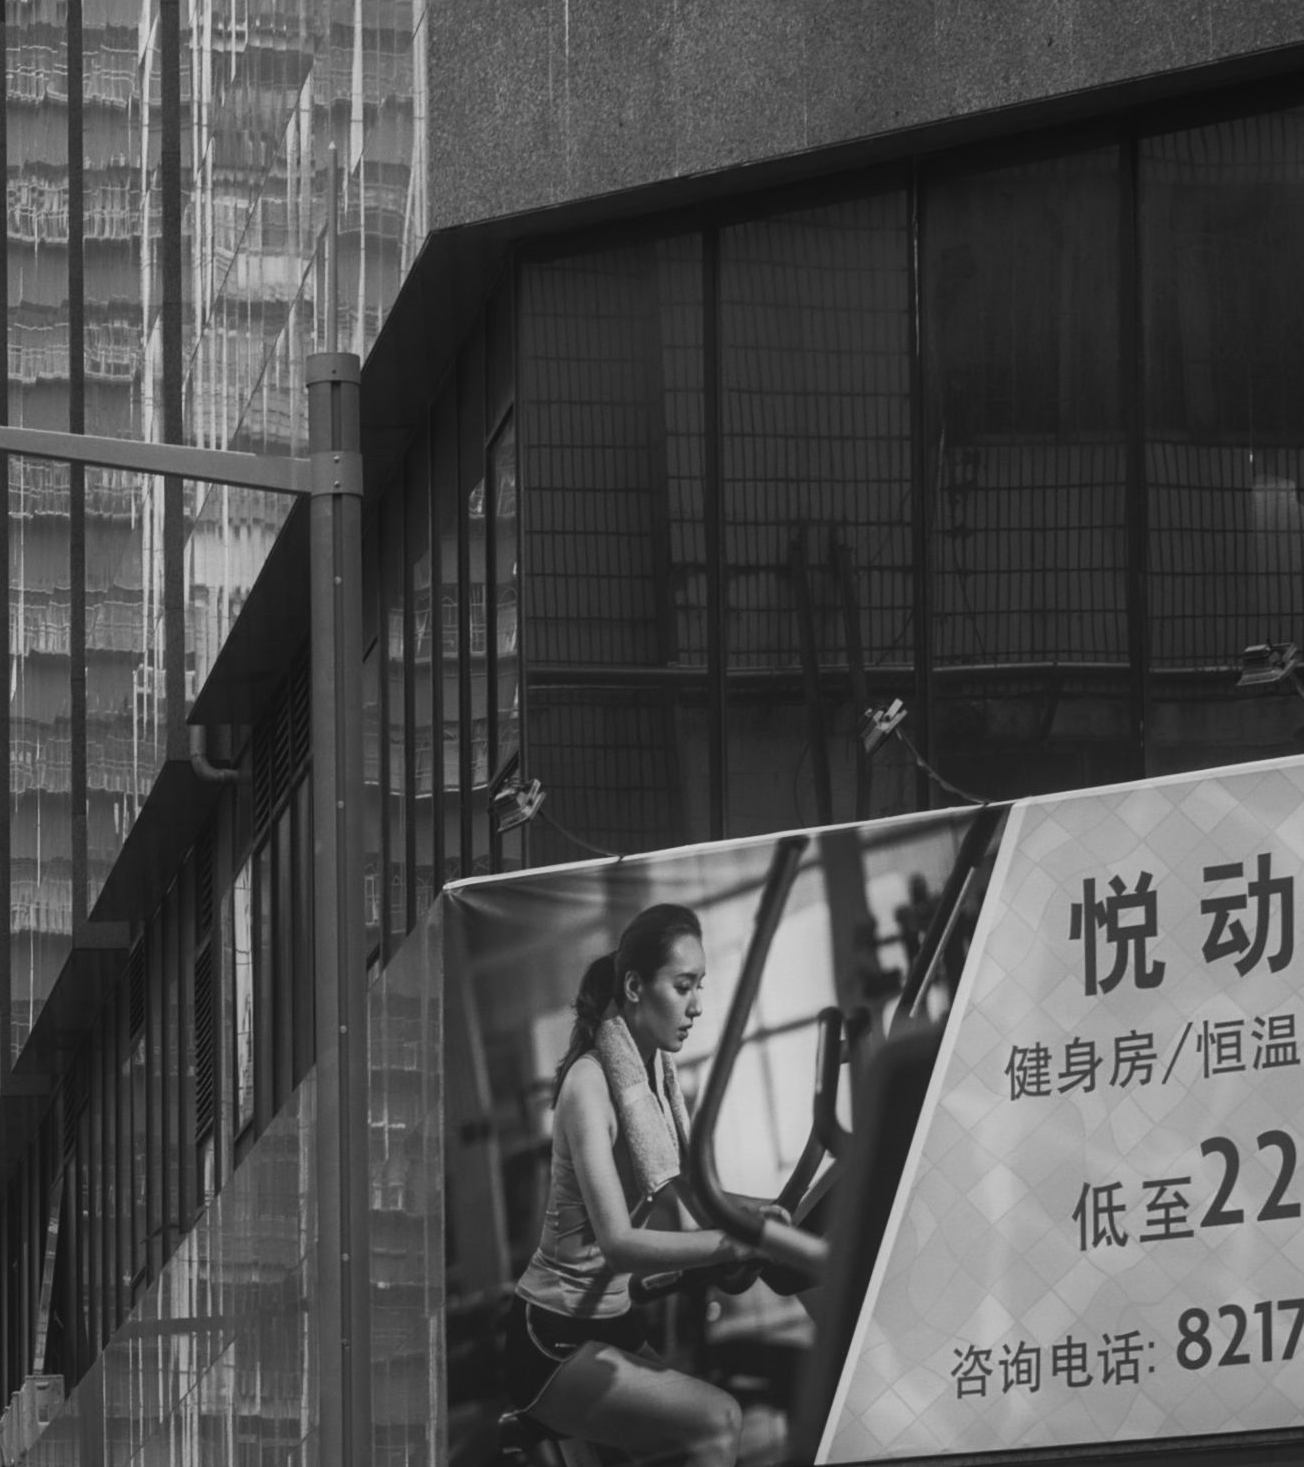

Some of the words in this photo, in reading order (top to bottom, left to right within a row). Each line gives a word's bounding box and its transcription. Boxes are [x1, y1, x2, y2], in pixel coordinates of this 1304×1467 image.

[1069, 853, 1297, 997] 悦动
[1005, 1013, 1302, 1102] 健身房/恒温
